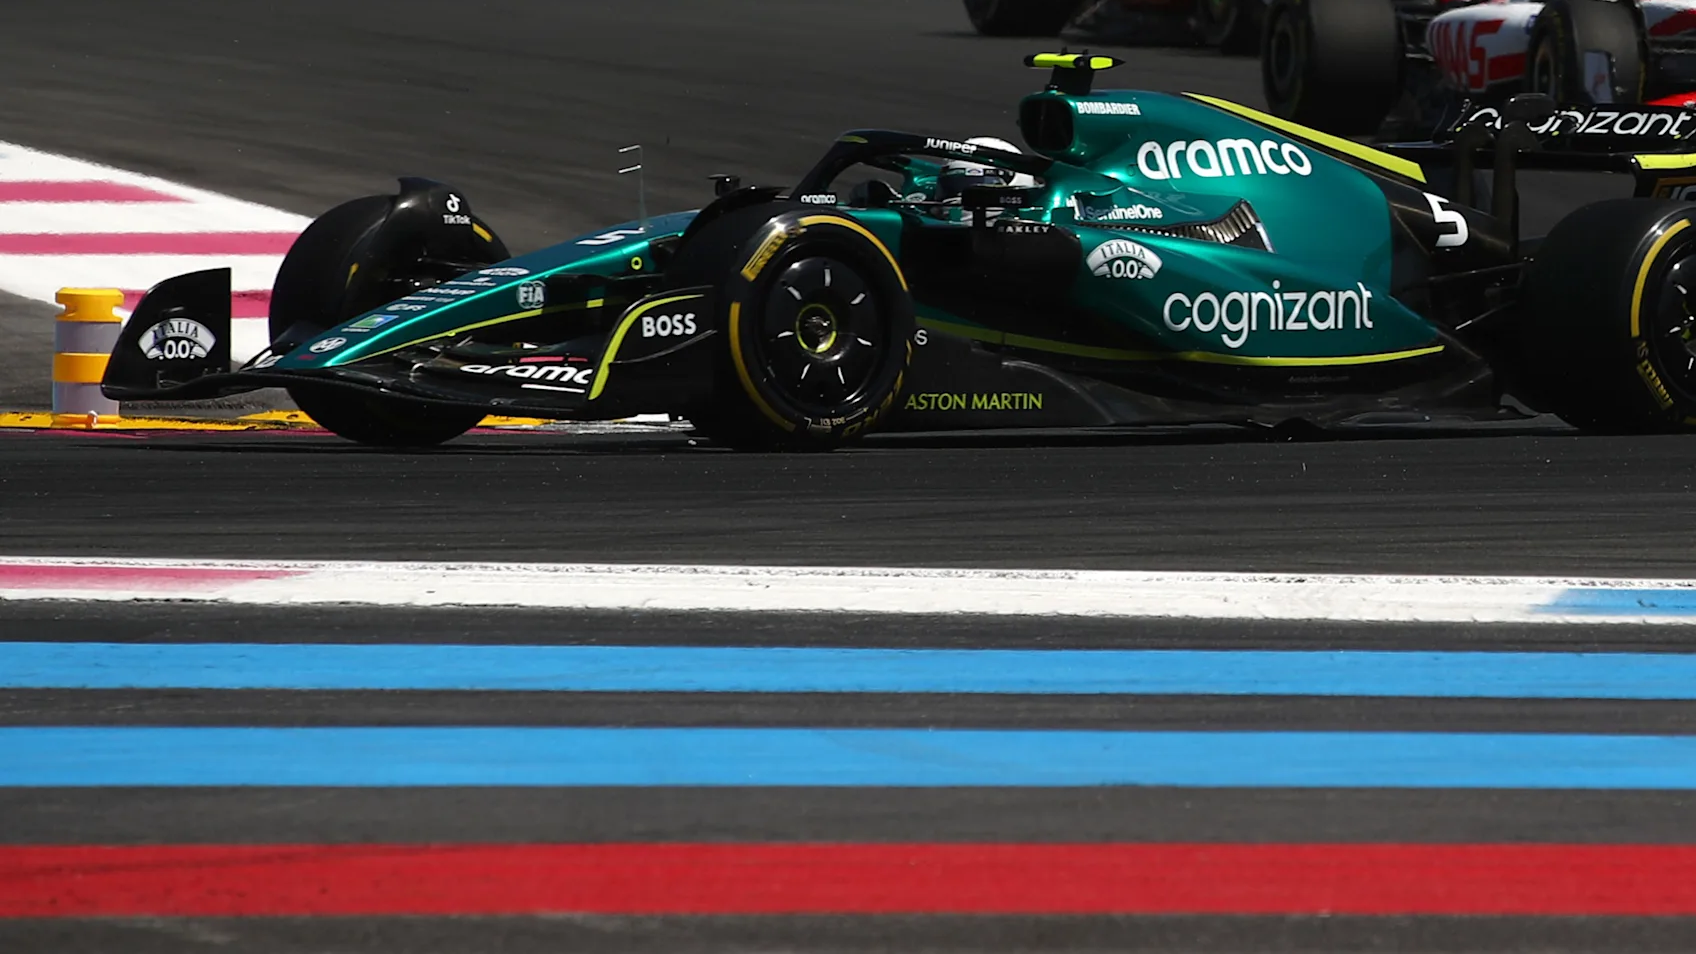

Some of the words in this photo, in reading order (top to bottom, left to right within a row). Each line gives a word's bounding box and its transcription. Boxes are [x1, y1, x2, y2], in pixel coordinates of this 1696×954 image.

[1077, 101, 1141, 115] BOMBARDIER
[1137, 138, 1312, 180] aramco
[801, 194, 837, 204] aramco
[443, 214, 471, 225] TikTok
[1086, 204, 1163, 220] SentinelOne
[1423, 192, 1468, 246] 5
[1100, 242, 1146, 259] ITALIA
[1163, 279, 1374, 349] cognizant
[152, 321, 200, 339] ITALIA
[641, 313, 697, 338] BOSS
[460, 363, 594, 384] aramc
[905, 394, 966, 410] ASTON
[971, 392, 1043, 410] MARTIN
